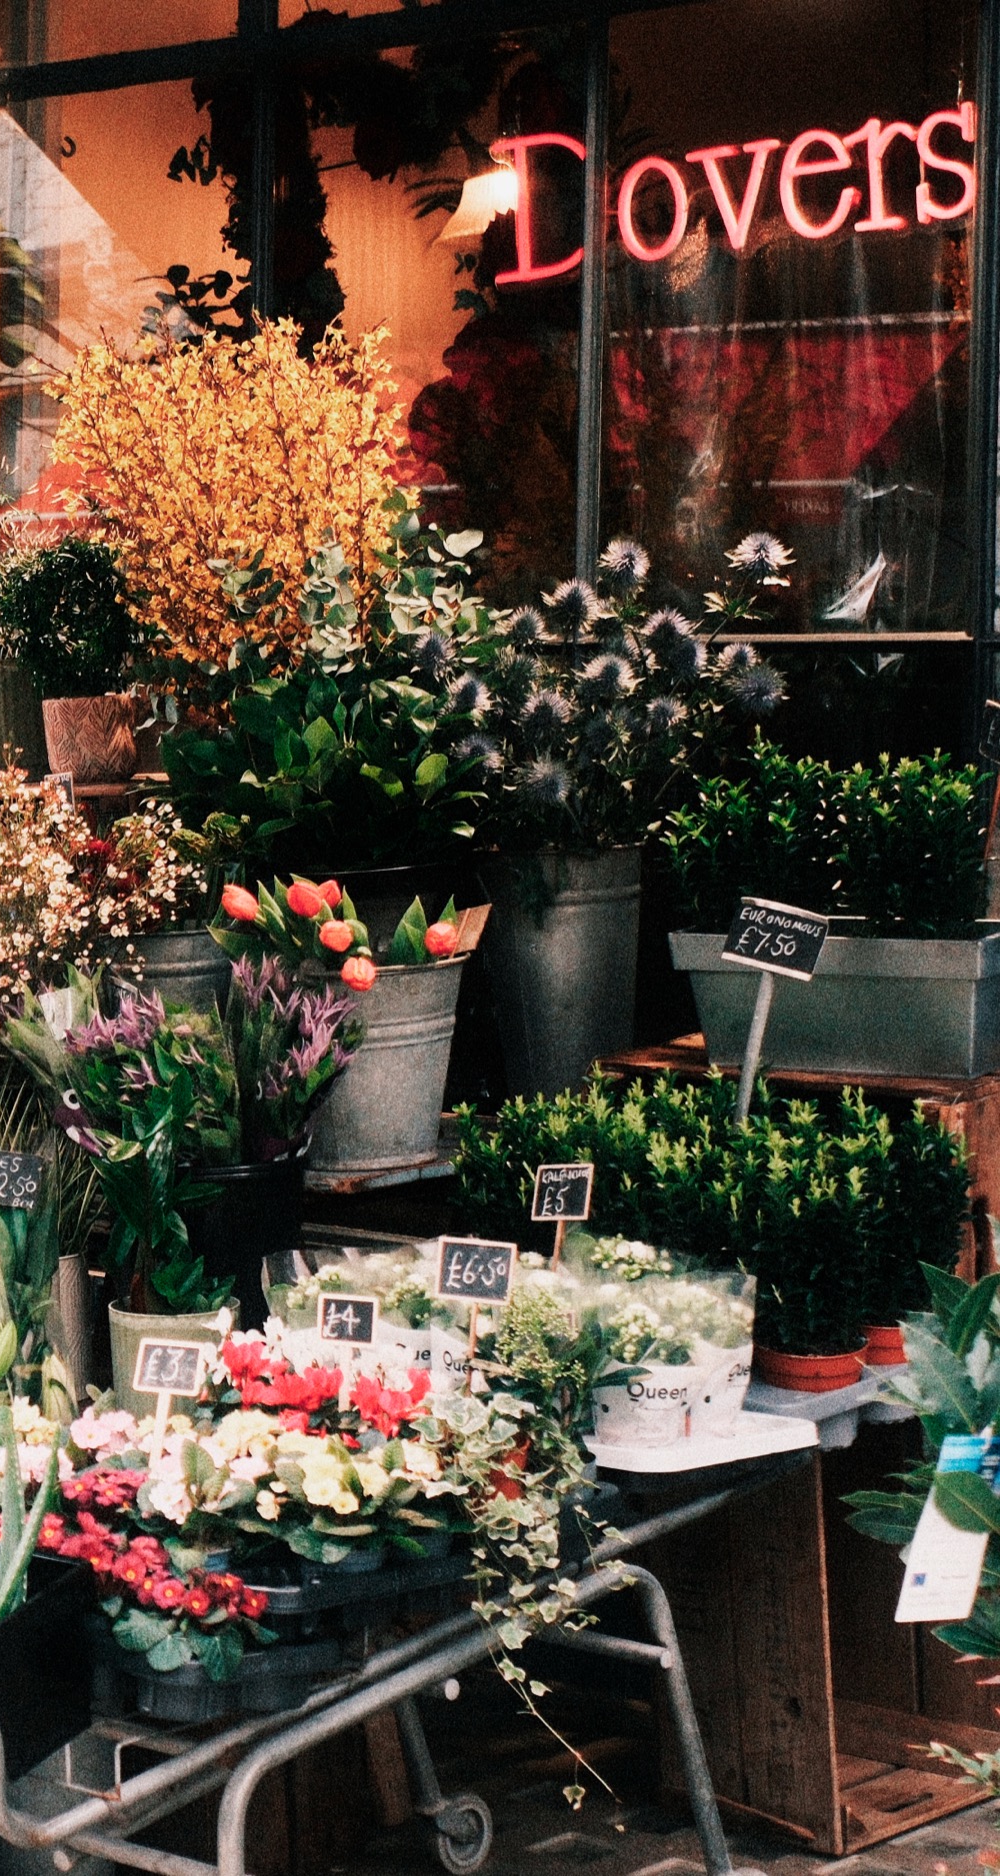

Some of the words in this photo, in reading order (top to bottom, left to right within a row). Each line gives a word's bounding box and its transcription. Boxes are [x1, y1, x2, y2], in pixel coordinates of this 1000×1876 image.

[490, 101, 975, 285] Dovers
[542, 1186, 570, 1216] £5
[324, 1302, 360, 1337] £4
[144, 1348, 185, 1382] £3
[627, 1382, 687, 1402] Queen
